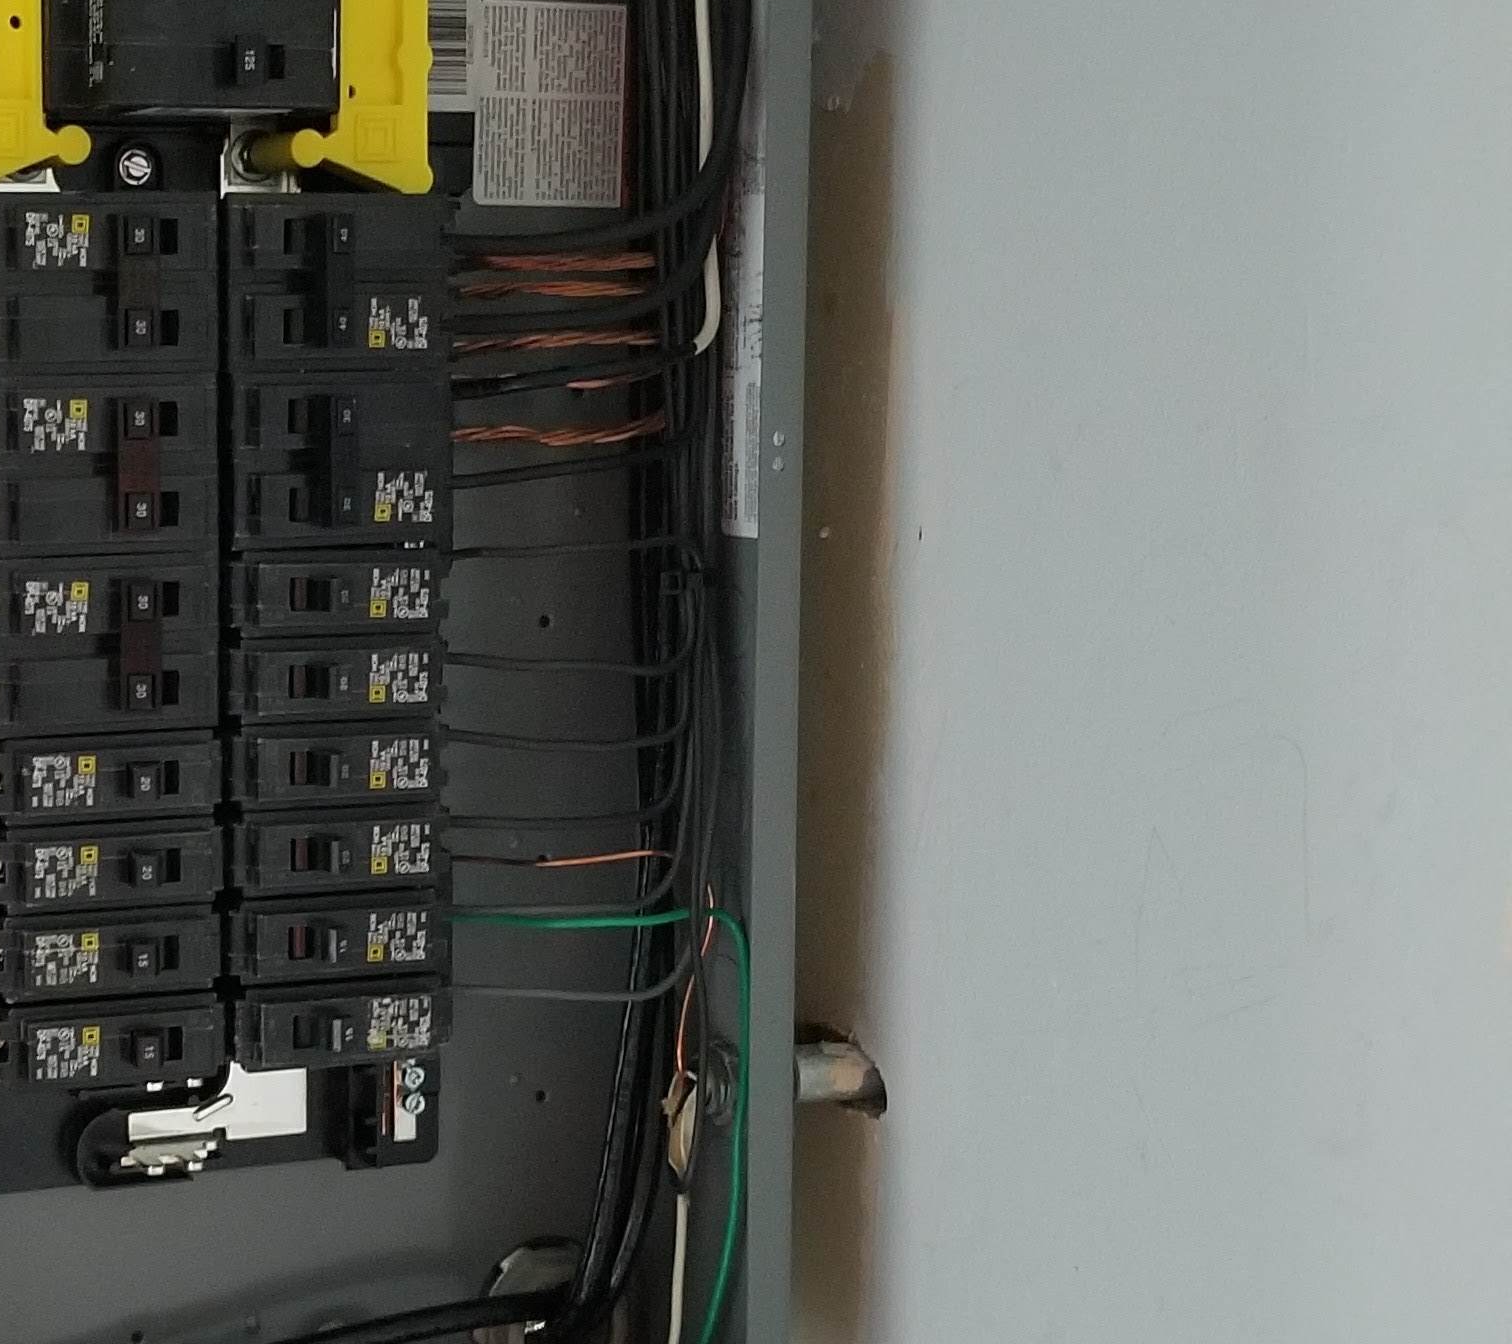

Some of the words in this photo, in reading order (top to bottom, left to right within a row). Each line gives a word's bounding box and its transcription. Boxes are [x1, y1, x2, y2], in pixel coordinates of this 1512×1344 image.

[245, 49, 256, 71] 125
[136, 502, 147, 518] 30
[136, 683, 147, 699] 30
[140, 776, 151, 791] 20
[138, 953, 148, 968] 15
[144, 1045, 154, 1060] 15
